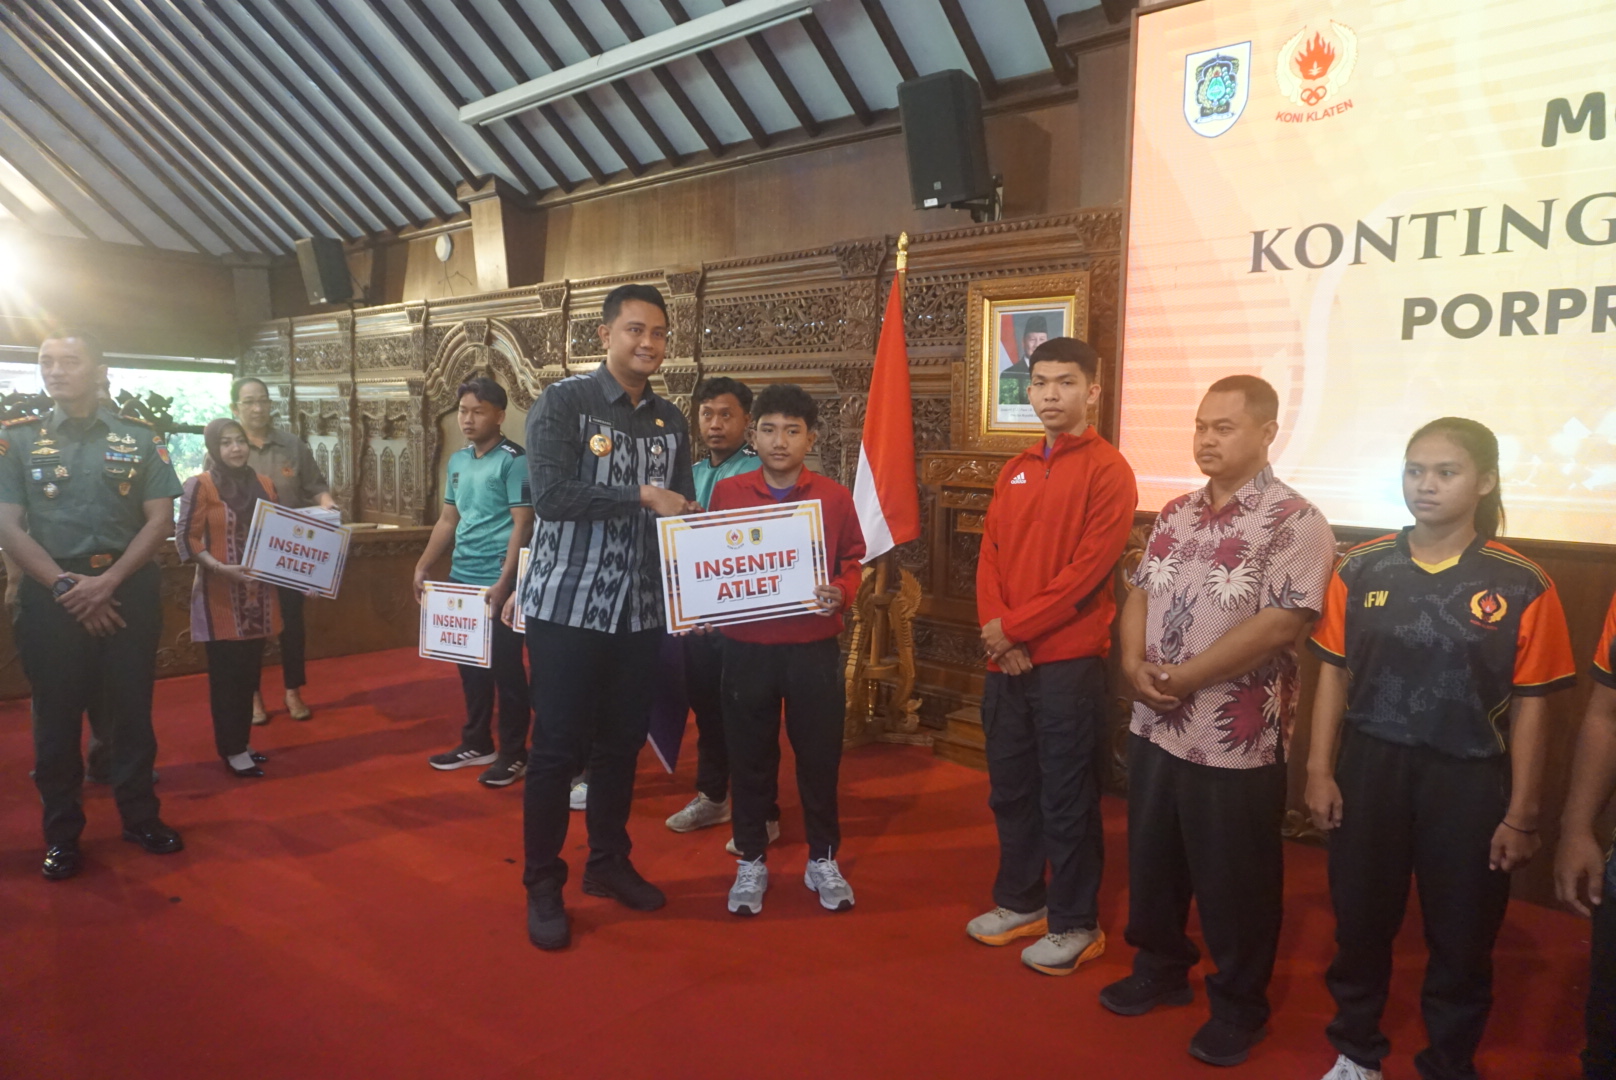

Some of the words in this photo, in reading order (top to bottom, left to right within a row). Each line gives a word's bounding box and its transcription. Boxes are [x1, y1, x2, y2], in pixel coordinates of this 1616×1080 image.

[1275, 111, 1304, 123] KONI
[1306, 99, 1354, 122] KLATEN
[1248, 191, 1616, 274] KONTING
[1401, 285, 1616, 340] PORPR
[269, 536, 330, 563] INSENTIF
[275, 555, 316, 576] ATLET
[695, 549, 798, 580] INSENTIF
[717, 575, 781, 601] ATLET
[433, 613, 477, 631] INSENTIF
[440, 631, 468, 646] ATLET
